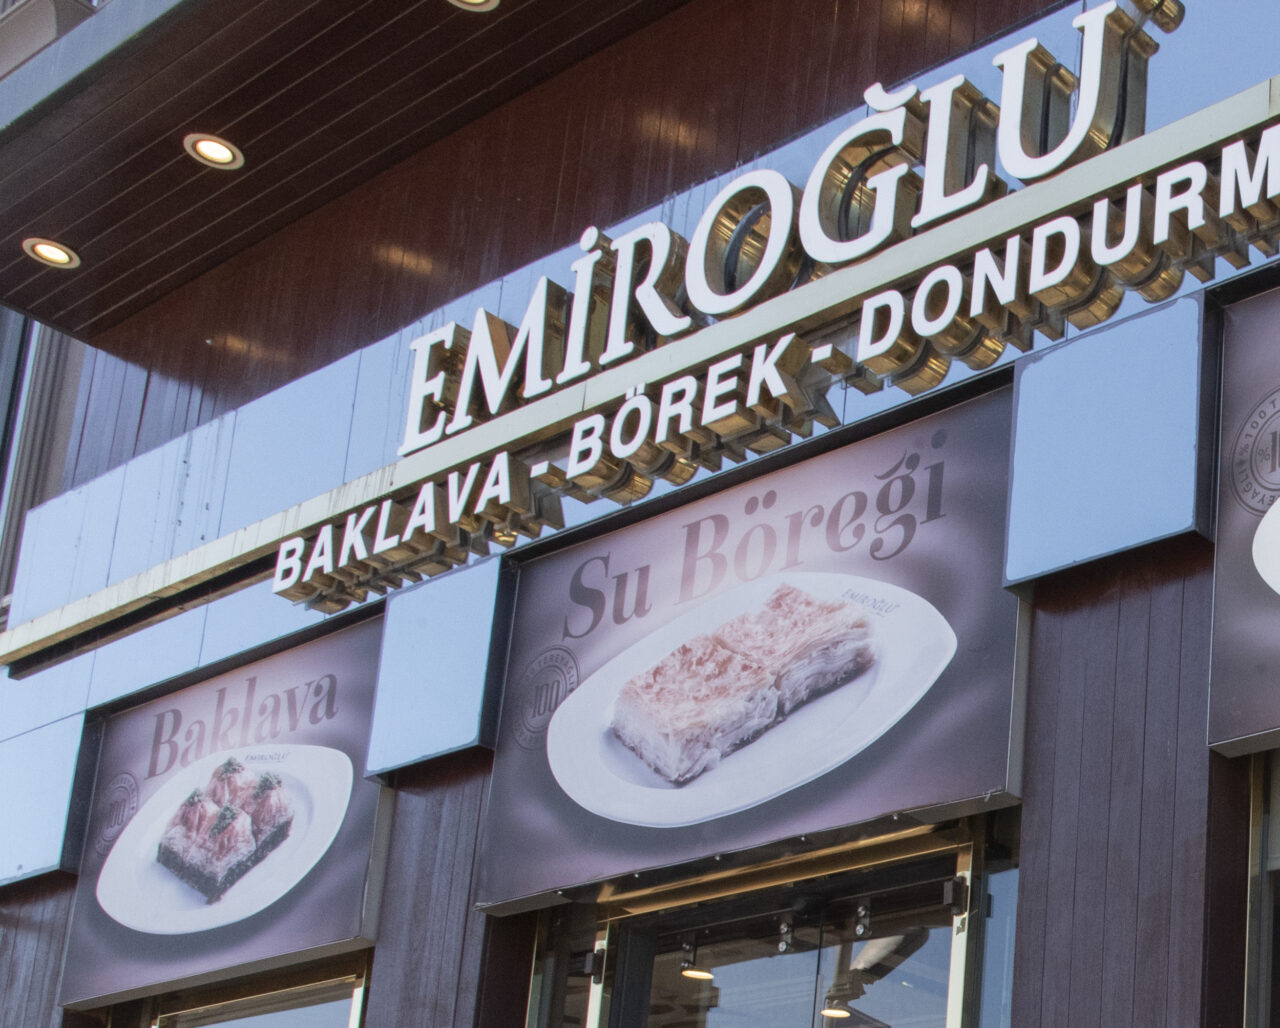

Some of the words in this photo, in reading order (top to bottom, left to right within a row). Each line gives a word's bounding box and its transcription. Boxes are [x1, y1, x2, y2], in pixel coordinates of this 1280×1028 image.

[396, 4, 1118, 458] EMİROĞLU
[272, 450, 512, 593] BAKLAVA
[565, 332, 797, 480] BÖREK
[561, 550, 653, 641] Su
[674, 427, 949, 606] Böreği
[144, 672, 340, 780] Baklava
